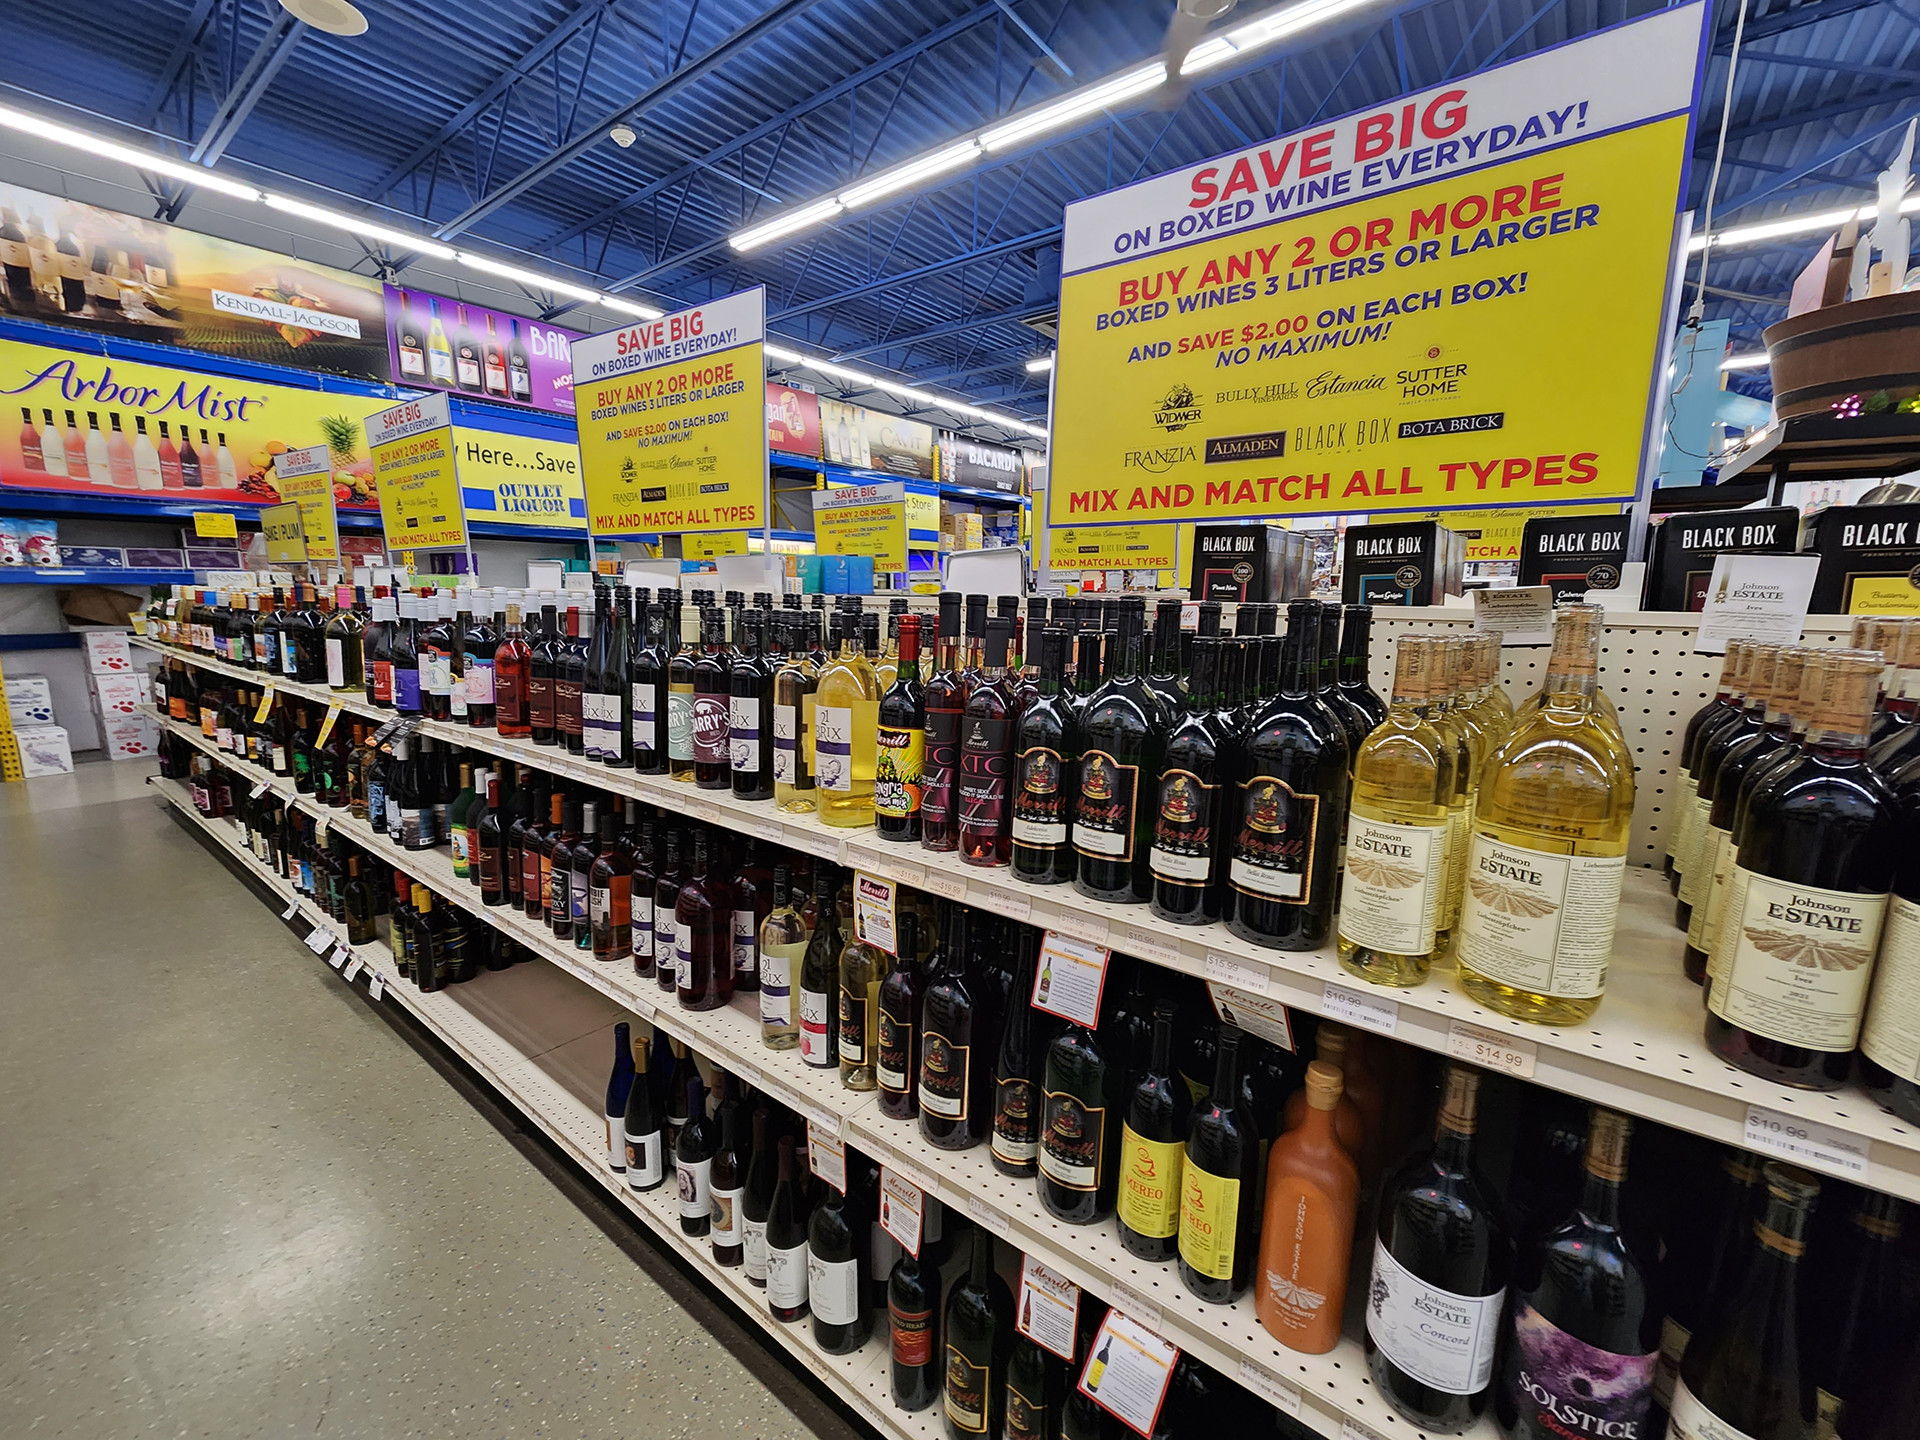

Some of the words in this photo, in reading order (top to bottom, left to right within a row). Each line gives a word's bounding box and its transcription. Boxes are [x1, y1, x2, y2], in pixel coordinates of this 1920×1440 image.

[1189, 129, 1336, 209] SAVE
[1353, 89, 1469, 164] BIG
[1114, 226, 1152, 254] ON
[1158, 198, 1255, 243] BOXED
[1264, 169, 1353, 213] WINE
[1362, 100, 1589, 189] EVERYDAY!
[1119, 265, 1190, 307] BUY
[1197, 243, 1282, 290] ANY
[1291, 235, 1316, 269] 2
[1328, 217, 1394, 258] OR
[1408, 172, 1565, 241] MORE
[1096, 300, 1170, 332] BOXED
[1177, 280, 1257, 315] WINES
[1263, 275, 1280, 297] 3
[1286, 252, 1386, 292] LITERS
[1394, 240, 1442, 268] OR
[1449, 203, 1601, 257] LARGER
[214, 293, 359, 335] KENDALL-JACKSON
[1127, 340, 1172, 365] AND
[1176, 328, 1235, 355] SAVE
[1240, 314, 1309, 346] $2.00
[1315, 304, 1356, 329] ON
[1362, 288, 1443, 321] EACH
[1450, 270, 1528, 306] BOX!
[617, 321, 665, 356] SAVE
[670, 310, 704, 342] BIG
[1215, 347, 1251, 369] NO
[1256, 320, 1393, 362] MAXIMUM!
[592, 363, 606, 377] ON
[608, 354, 642, 374] BOXED
[643, 346, 672, 364] WINE
[674, 327, 737, 357] EVERYDAY!
[597, 387, 622, 408] BUY
[625, 380, 653, 404] ANY
[656, 378, 665, 396] 2
[667, 375, 688, 392] OR
[691, 362, 734, 388] MORE
[1306, 369, 1389, 400] Estancia
[1396, 363, 1468, 385] SUTTER
[0, 359, 161, 407] Arbor
[145, 380, 265, 422] Mist
[1215, 387, 1263, 404] BULLY
[1266, 381, 1300, 397] HILL
[1252, 391, 1300, 404] VINEYARDS
[1402, 379, 1459, 398] HOME
[591, 407, 618, 422] BOXED
[620, 400, 648, 417] WINES
[649, 399, 655, 410] 3
[656, 391, 687, 409] LITERS
[689, 389, 703, 403] OR
[705, 380, 745, 400] LARGER
[383, 408, 405, 429] SAVE
[405, 403, 422, 423] BIG
[606, 430, 622, 442] AND
[623, 426, 643, 439] SAVE
[645, 422, 667, 435] $2.00
[668, 421, 681, 431] ON
[682, 415, 706, 430] EACH
[707, 411, 729, 425] BOX!
[1153, 408, 1203, 425] WIDMER
[1401, 420, 1447, 437] BOTA
[1449, 415, 1501, 433] BRICK
[637, 437, 650, 449] NO
[651, 430, 693, 447] MAXIMUM!
[1294, 422, 1347, 451] BLACK
[1356, 416, 1393, 446] BOX
[380, 452, 392, 464] BUY
[392, 447, 405, 461] ANY
[420, 438, 440, 453] MORE
[1210, 436, 1280, 457] ALMADEN
[968, 445, 1017, 473] BACARDÍ
[1123, 445, 1197, 474] FRANZIA
[498, 482, 564, 498] OUTLET
[834, 488, 858, 500] SAVE
[860, 486, 877, 498] BIG
[1068, 489, 1119, 514] MIX
[1126, 483, 1196, 511] AND
[1203, 472, 1331, 507] MATCH
[1341, 465, 1424, 498] ALL
[1437, 451, 1600, 493] TYPES
[501, 498, 566, 513] LIQUOR
[825, 512, 838, 521] BUY
[839, 511, 853, 520] ANY
[859, 510, 870, 518] OR
[870, 507, 892, 517] MORE
[911, 496, 935, 511] Store!
[596, 515, 615, 529] MIX
[618, 513, 641, 528] AND
[643, 510, 683, 527] MATCH
[687, 508, 710, 525] ALL
[713, 505, 756, 523] TYPES
[282, 522, 301, 540] PLUM
[411, 532, 429, 544] MATCH
[429, 532, 441, 543] ALL
[441, 530, 463, 541] TYPES
[1539, 533, 1586, 554] BLACK
[1591, 531, 1623, 551] BOX
[1682, 527, 1736, 549] BLACK
[1741, 524, 1777, 546] BOX
[1842, 522, 1909, 547] BLACK
[1202, 536, 1233, 552] BLACK
[1234, 536, 1256, 552] BOX
[1356, 538, 1393, 556] BLACK
[1397, 536, 1422, 554] BOX
[1466, 546, 1506, 557] ATCH
[880, 562, 903, 571] TYPES
[1057, 559, 1077, 567] AND
[1079, 558, 1112, 568] MATCH
[1114, 557, 1134, 566] ALL
[1135, 556, 1169, 566] TYPES
[1596, 572, 1610, 580] 70
[1741, 582, 1780, 591] Johnson
[1492, 592, 1533, 600] ESTATE
[1732, 590, 1785, 600] ESTATE
[1746, 604, 1764, 612] Ives
[820, 709, 830, 726] 21
[816, 724, 842, 744] BRIX
[960, 754, 1008, 776] XTC
[1355, 835, 1413, 859] ESTATE
[1364, 828, 1403, 843] Johnson
[1490, 849, 1532, 868] Johnson
[1479, 856, 1543, 887] ESTATE
[860, 879, 890, 900] Merrill
[1788, 894, 1851, 914] Johnson
[1767, 902, 1863, 933] ESTATE
[1127, 931, 1156, 946] $10.99
[1207, 955, 1239, 973] $15.99
[1219, 987, 1277, 1016] Merrill
[1325, 989, 1362, 1009] $10.99
[1475, 1043, 1523, 1068] $14.99
[1747, 1116, 1810, 1142] $10.99
[886, 1176, 918, 1201] Merrill
[1125, 1174, 1164, 1200] MEREO
[1030, 1265, 1072, 1293] Merrill
[1414, 1297, 1472, 1326] ESTATE
[1423, 1292, 1468, 1314] Johnson
[1419, 1322, 1471, 1346] Concord
[1518, 1370, 1640, 1440] SOLSTICE
